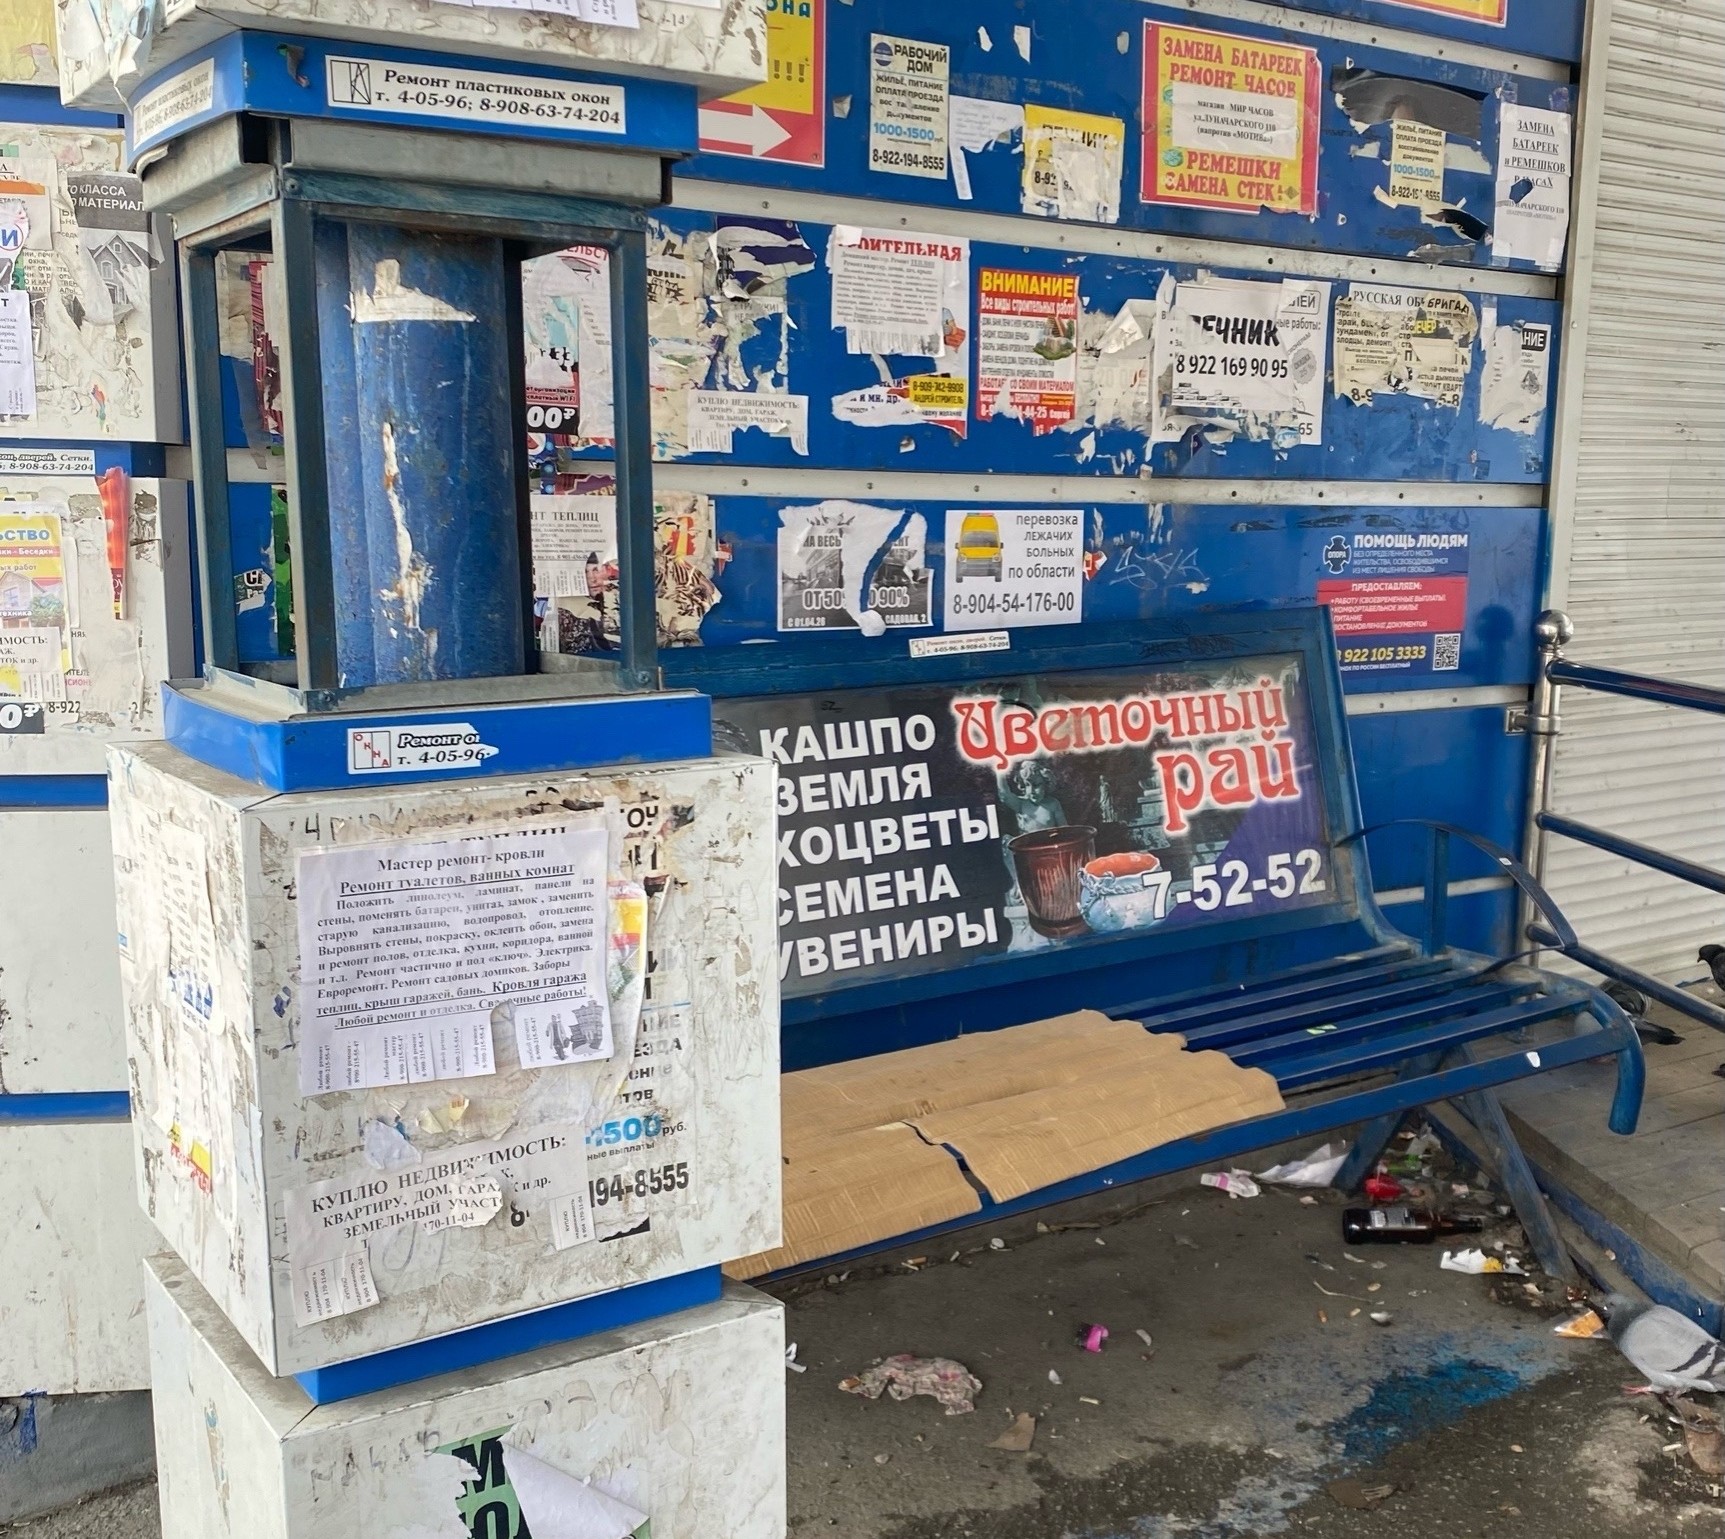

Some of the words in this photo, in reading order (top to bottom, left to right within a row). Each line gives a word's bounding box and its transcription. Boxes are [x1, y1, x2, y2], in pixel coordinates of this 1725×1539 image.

[894, 44, 947, 63] РАБОЧИЙ
[1163, 36, 1224, 64] ЗАМЕНА
[1230, 47, 1303, 77] БАТАРЕЕК
[906, 60, 933, 74] ДОМ
[383, 68, 450, 89] Ремонт
[456, 79, 566, 101] пластиковых
[571, 91, 611, 105] окон
[1169, 62, 1236, 89] РЕМОНТ
[1244, 74, 1297, 98] ЧАСОВ
[375, 90, 390, 102] т.
[397, 89, 473, 112] 4-05-96;
[479, 97, 621, 125] 8-908-63-74-204
[1248, 105, 1275, 117] ЧАСОВ
[874, 123, 934, 140] 1000-1500
[1516, 119, 1555, 136] ЗАМЕНА
[1512, 137, 1560, 155] БАТАРЕЕК
[872, 148, 944, 171] 8-922-194-8555
[1186, 151, 1282, 180] РЕМЕШКИ
[1511, 156, 1566, 173] РЕМЕШКОВ
[79, 184, 127, 197] КЛАССА
[1164, 171, 1229, 197] ЗАМЕНА
[1353, 290, 1402, 306] РУССКАЯ
[1175, 354, 1185, 374] 8
[1189, 354, 1216, 375] 922
[1220, 356, 1247, 376] 169
[1250, 358, 1268, 377] 90
[1271, 359, 1288, 379] 95
[9, 462, 94, 471] 8-908-63-74-204
[553, 511, 599, 522] ТЕПЛИЦ
[1015, 514, 1078, 529] перевозка
[817, 535, 842, 547] ВЕСЬ
[1354, 534, 1416, 549] ПОМОЩЬ
[1416, 534, 1468, 550] ЛЮДЯМ
[1008, 567, 1023, 579] по
[1026, 563, 1075, 578] области
[953, 591, 1075, 614] 8-904-54-176-00
[1344, 647, 1368, 662] 922
[1370, 646, 1394, 661] 105
[1395, 645, 1427, 660] 3333
[955, 680, 1287, 770] Цветочный
[397, 733, 463, 748] Ремонт
[759, 714, 936, 766] КАШПО
[397, 756, 411, 765] т.
[777, 762, 932, 817] ЗЕМЛЯ
[1157, 729, 1300, 832] рай
[377, 857, 433, 872] Мастер
[437, 853, 491, 871] ремонт-
[495, 849, 545, 866] кровли
[340, 879, 394, 894] Ремонт
[399, 873, 467, 890] туалетов,
[470, 868, 522, 883] ванных
[525, 863, 575, 877] комнат
[1142, 848, 1326, 919] 7-52-52
[336, 895, 395, 910] Положить
[405, 890, 465, 903] линолеум,
[475, 884, 524, 897] ламинат,
[534, 878, 572, 890] панели
[582, 876, 595, 886] на
[317, 914, 355, 928] стены,
[358, 909, 412, 923] поменять
[415, 902, 463, 916] батареи,
[507, 895, 539, 907] замок
[547, 890, 595, 902] заменить
[317, 928, 359, 942] старую
[372, 920, 451, 935] канализацию,
[464, 911, 527, 926] водопровод,
[318, 941, 382, 957] Выровнять
[385, 935, 423, 948] стены,
[425, 929, 481, 944] покраску,
[483, 925, 526, 937] оклеить
[529, 921, 557, 932] обои,
[559, 916, 594, 927] замена
[318, 963, 325, 971] и
[329, 957, 370, 972] ремонт
[373, 951, 410, 963] полов,
[412, 946, 460, 958] отделка,
[464, 942, 499, 955] кухни,
[502, 935, 554, 949] коридора,
[558, 930, 593, 942] ванной
[317, 983, 388, 999] Евроремонт.
[391, 976, 431, 990] Ремонт
[434, 971, 479, 985] садовых
[481, 965, 530, 978] домиков.
[532, 960, 571, 972] Заборы
[318, 977, 325, 985] и
[356, 967, 396, 980] Ремонт
[400, 961, 451, 974] частично
[455, 959, 463, 967] и
[466, 956, 485, 966] под
[364, 997, 400, 1011] крыш
[456, 986, 486, 998] бань.
[492, 977, 540, 994] Кровля
[543, 971, 587, 987] гаража
[334, 1014, 374, 1029] Любой
[376, 1009, 417, 1024] ремонт
[420, 1009, 427, 1018] и
[543, 986, 587, 1003] работы!
[662, 1121, 688, 1137] руб.
[609, 1141, 656, 1157] выплаты
[312, 1179, 389, 1214] КУПЛЮ
[323, 1197, 408, 1228] КВАРТИРУ,
[414, 1183, 453, 1205] ДОМ,
[343, 1201, 441, 1240] ЗЕМЕЛЬНЫЙ
[522, 1181, 530, 1191] и
[533, 1176, 552, 1189] др.
